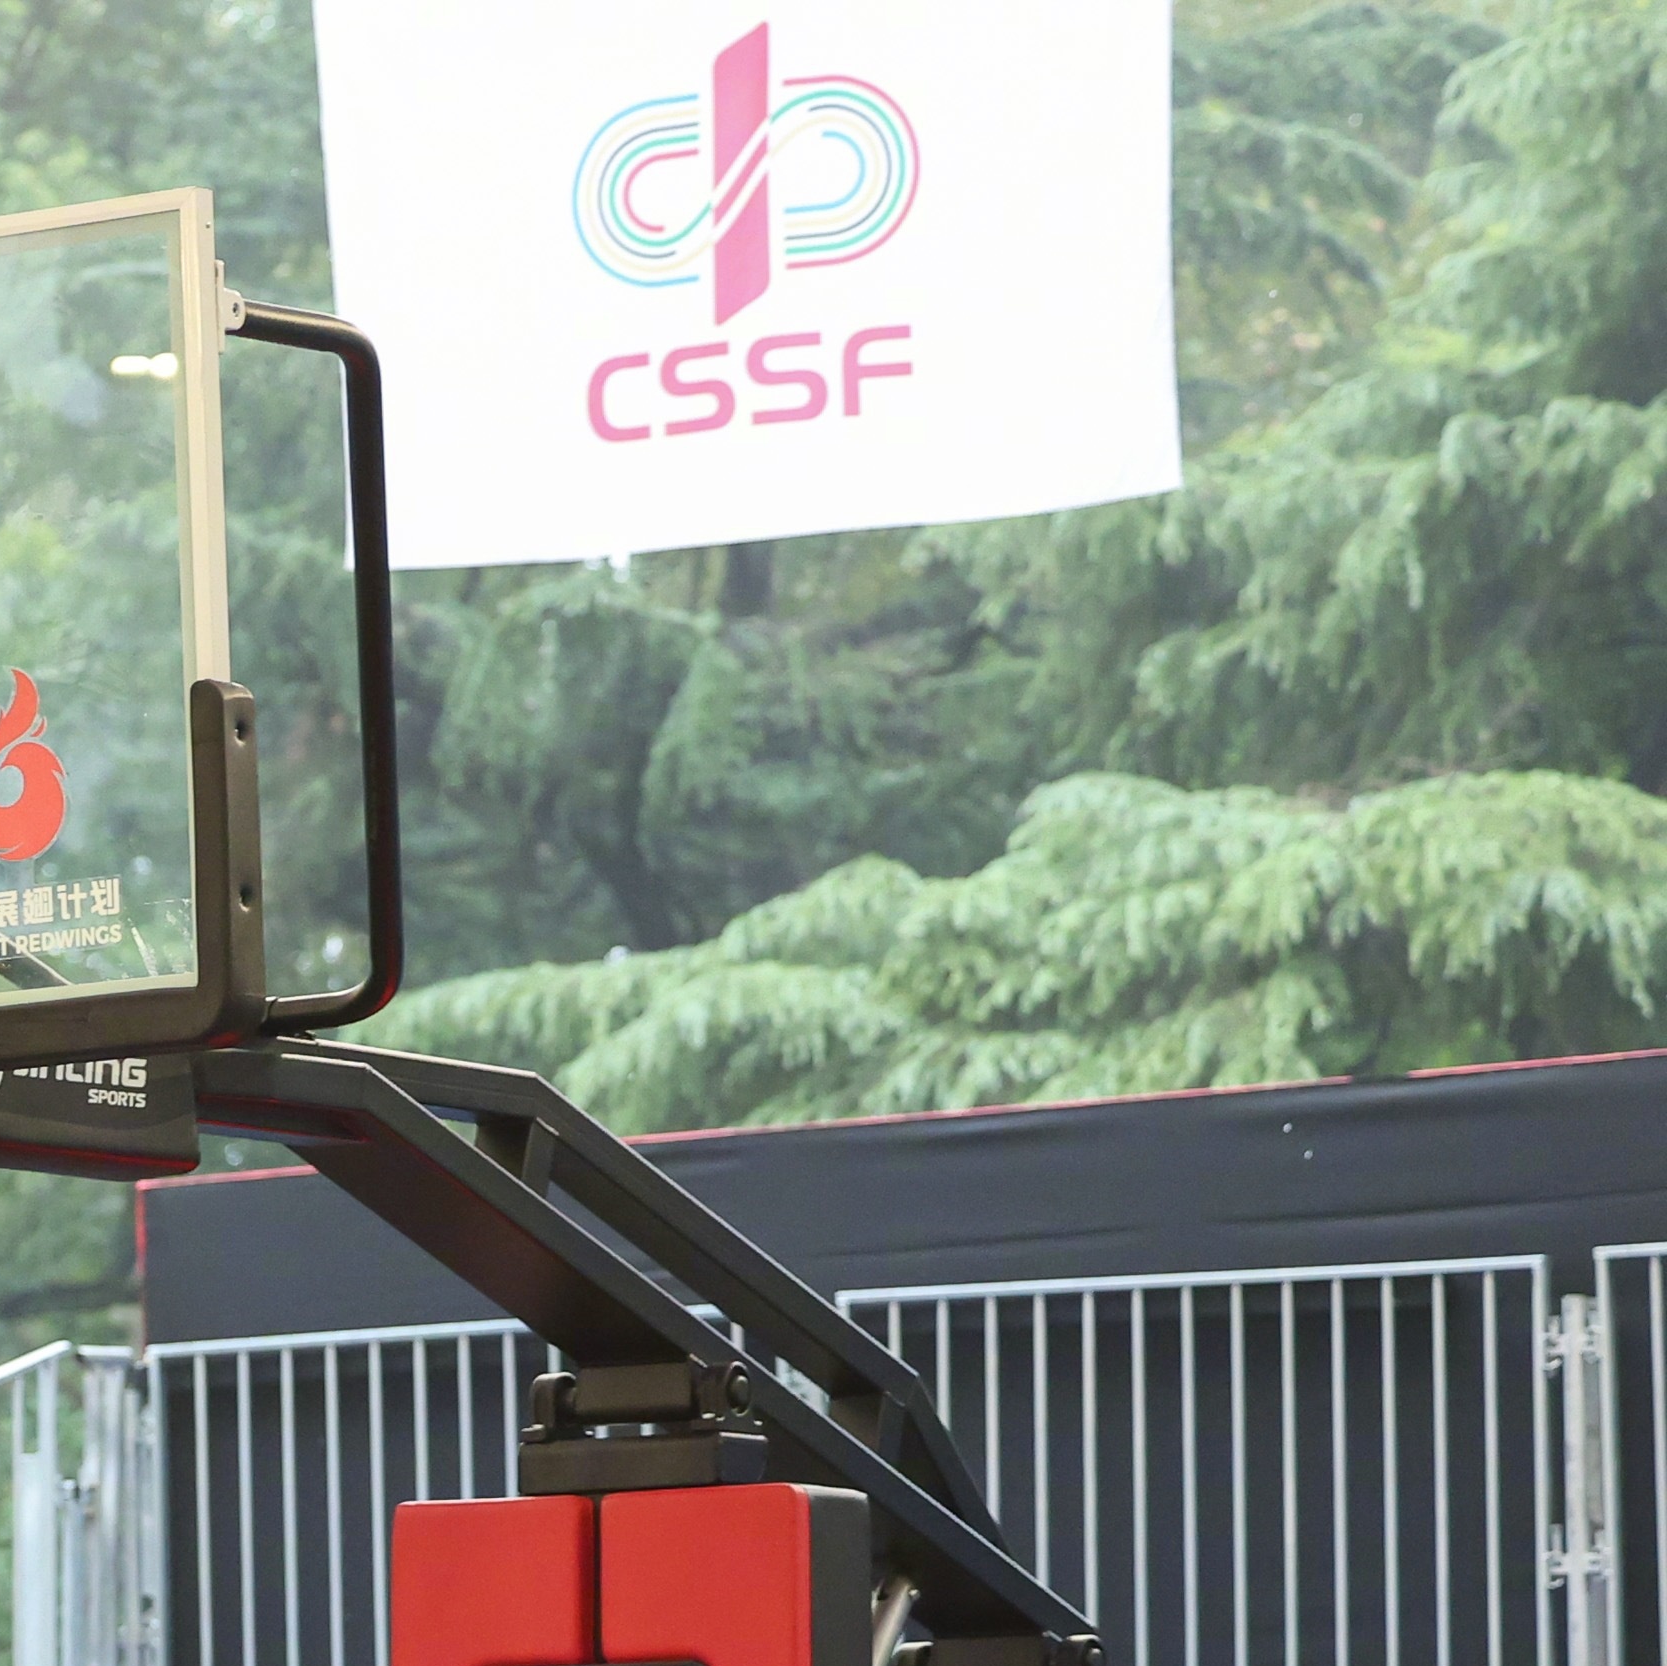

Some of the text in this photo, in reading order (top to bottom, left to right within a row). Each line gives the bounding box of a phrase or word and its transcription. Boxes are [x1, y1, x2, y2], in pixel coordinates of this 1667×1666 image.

[587, 324, 913, 442] CSSF
[16, 923, 123, 955] REDWINGS
[87, 1088, 147, 1108] SPORTS
